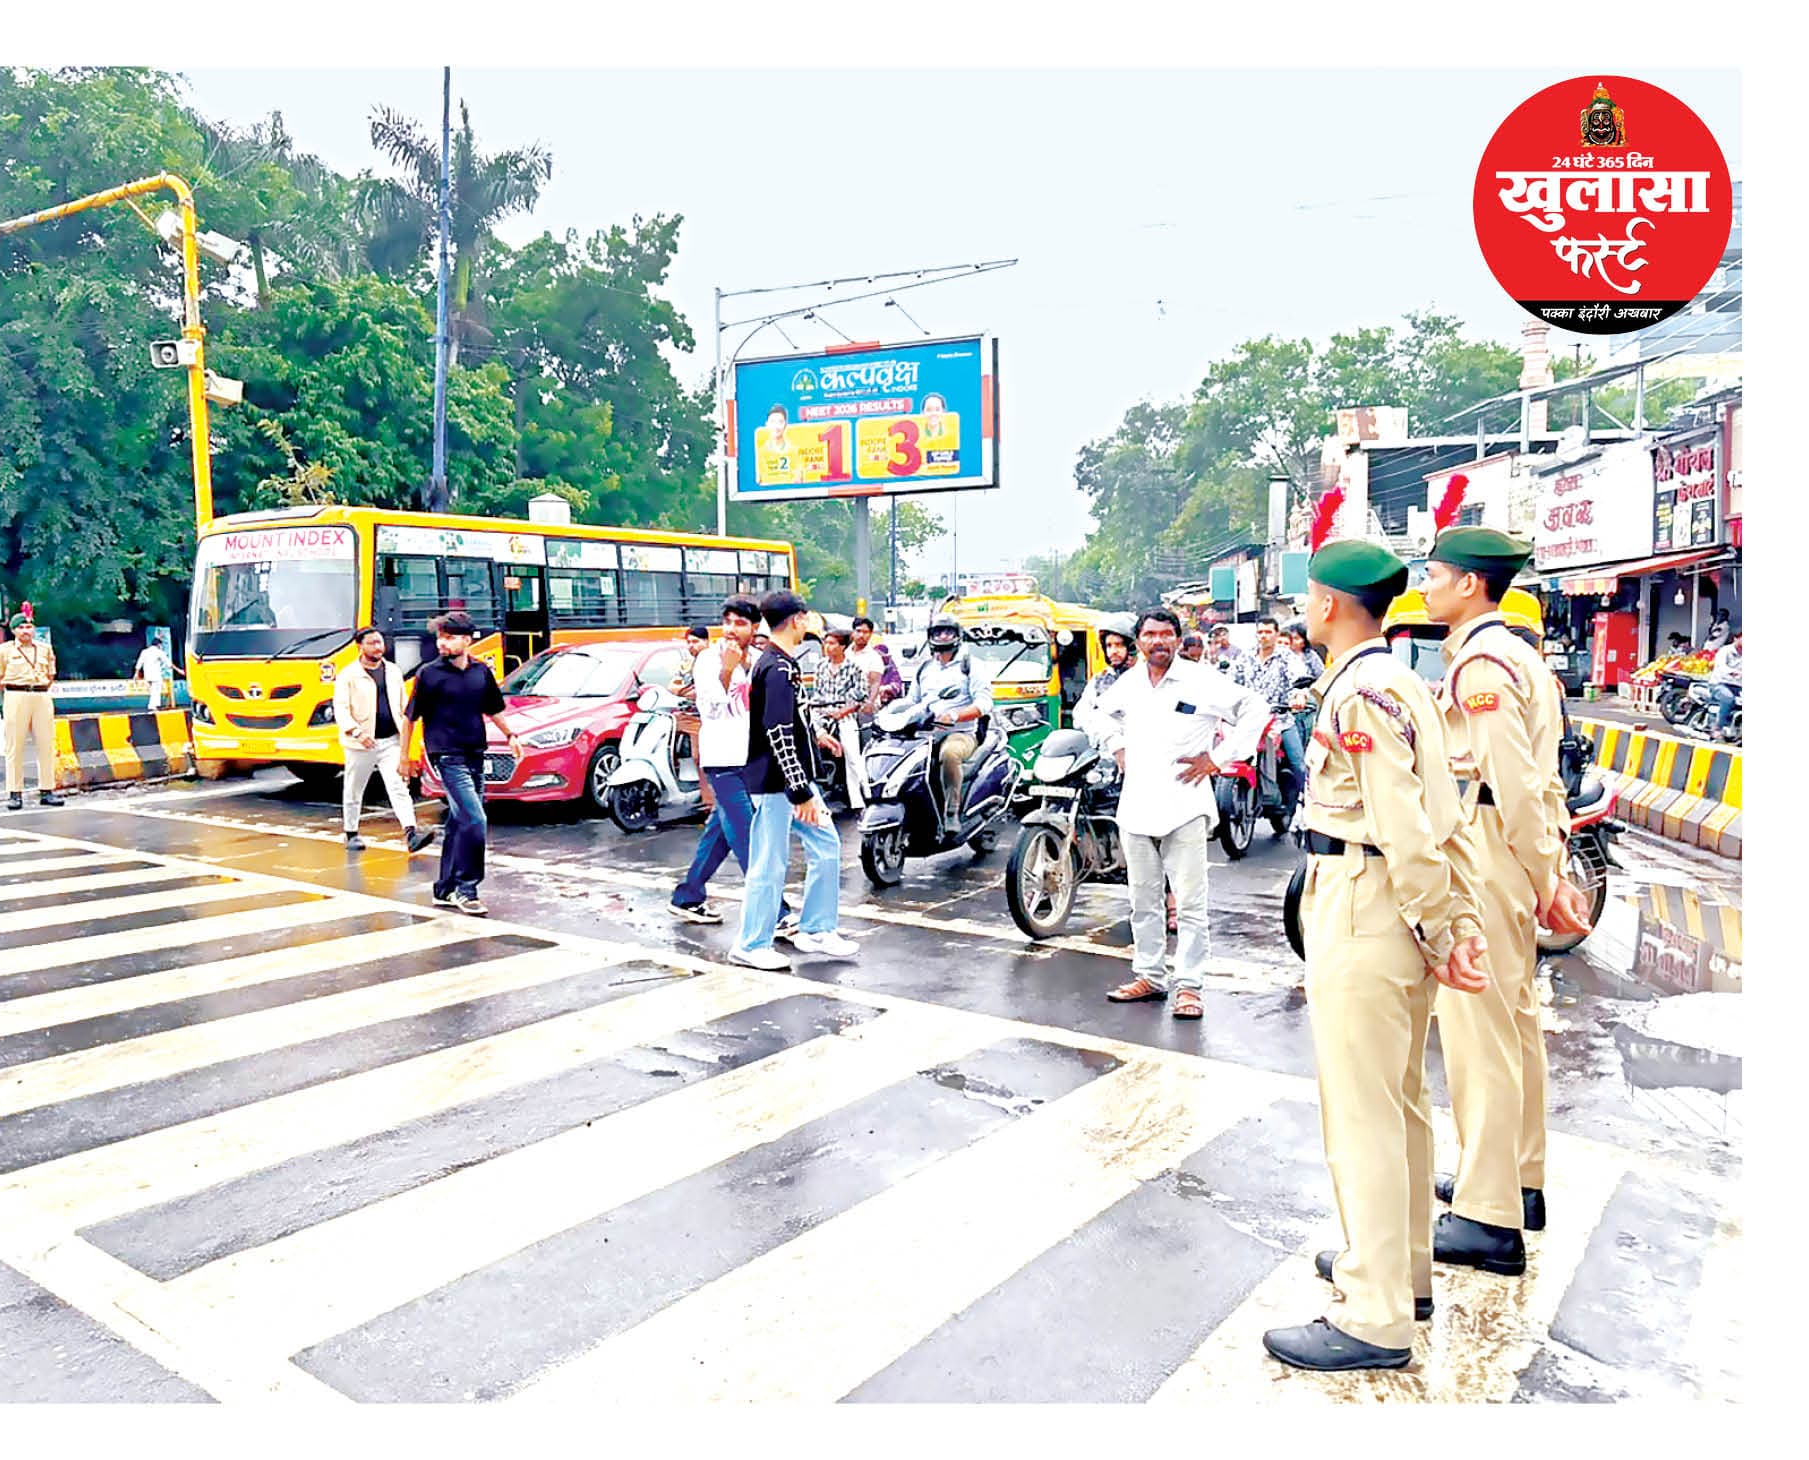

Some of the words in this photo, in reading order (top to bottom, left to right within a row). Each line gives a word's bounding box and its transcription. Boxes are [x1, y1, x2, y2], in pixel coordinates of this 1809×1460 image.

[820, 361, 920, 393] कल्पवृक्ष
[805, 404, 831, 417] NEET
[860, 399, 905, 414] RESULTS
[817, 424, 852, 482] 1
[886, 420, 922, 476] 3
[779, 457, 789, 470] 2
[224, 533, 284, 551] MOUNT
[287, 530, 345, 546] INDEX
[1467, 693, 1496, 710] NCC
[1342, 734, 1368, 749] NCC
